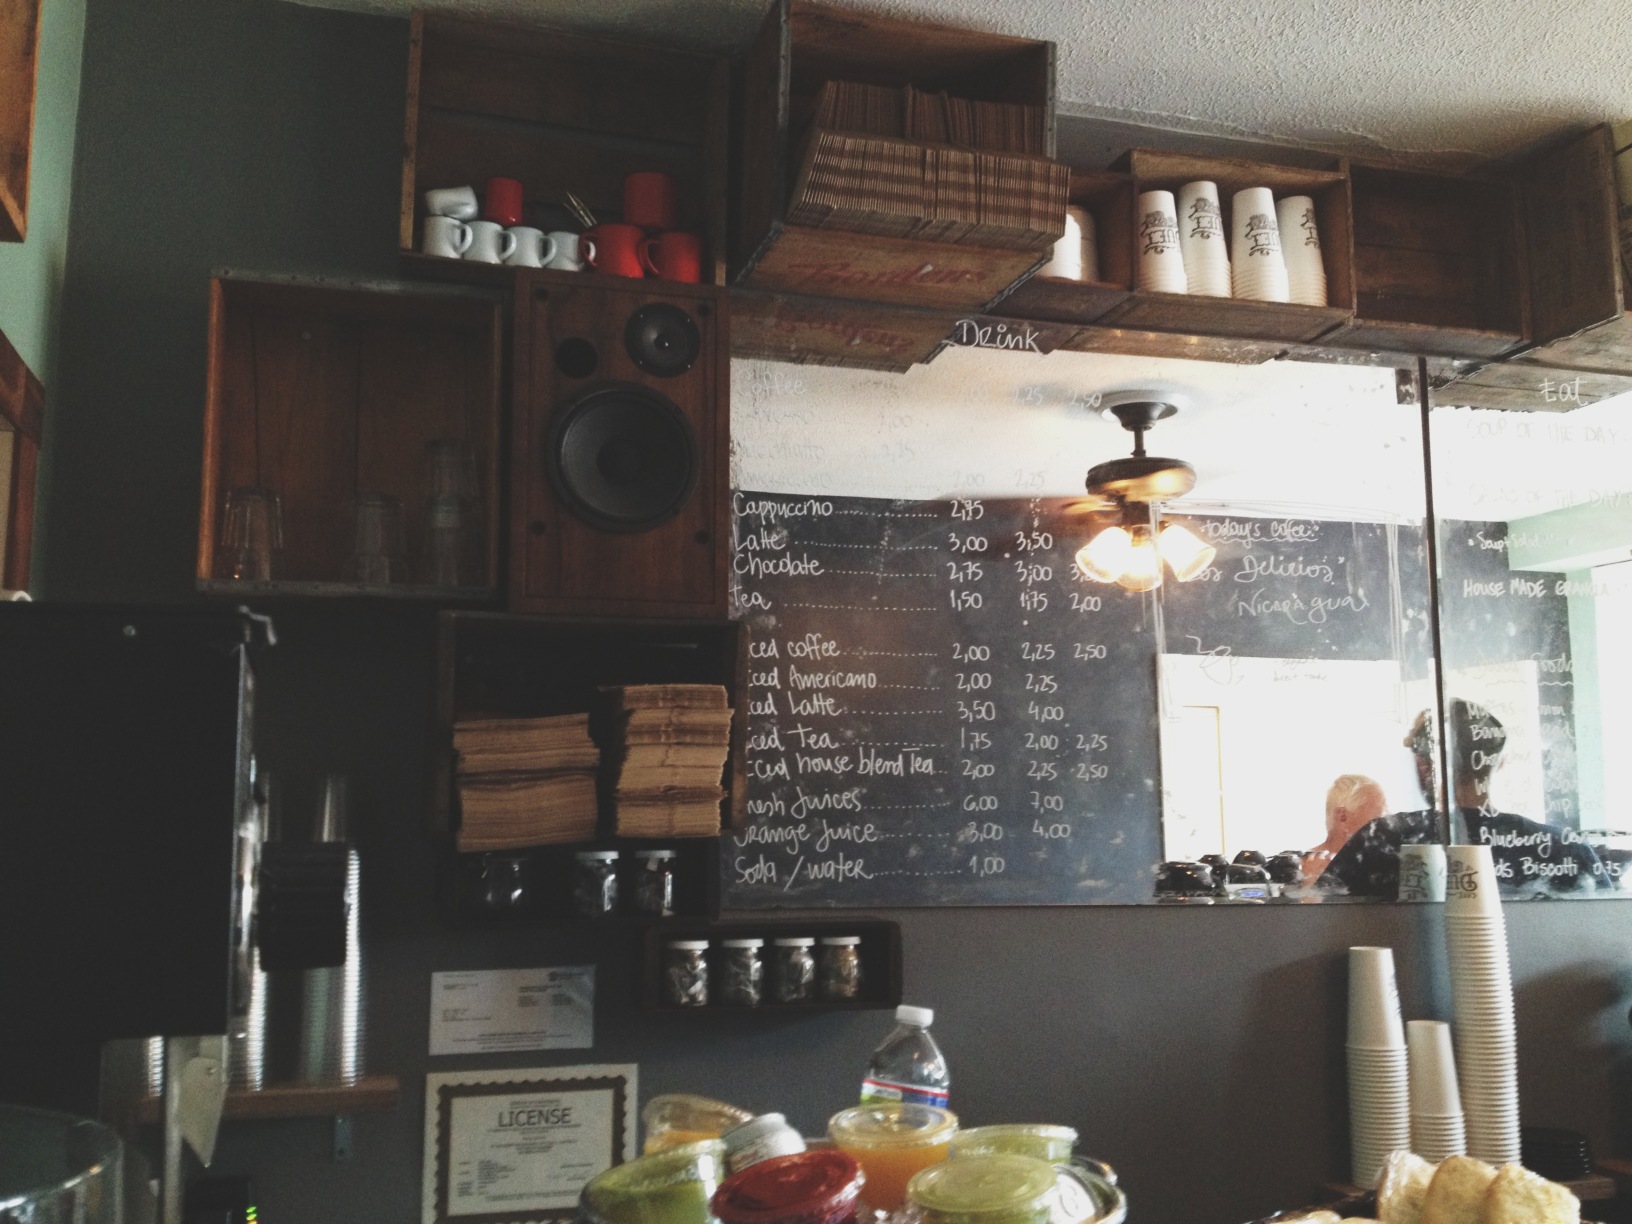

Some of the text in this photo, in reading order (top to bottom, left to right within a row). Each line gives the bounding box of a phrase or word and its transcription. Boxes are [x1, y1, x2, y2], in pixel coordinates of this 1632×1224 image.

[733, 492, 833, 525] Cappuccino
[732, 524, 1053, 553] Latte 3,00 3,50
[733, 552, 824, 579] Chocolate
[946, 562, 984, 582] 2,75
[1014, 561, 1053, 587] 3,00
[950, 589, 983, 612] 1,50
[1020, 590, 1048, 612] 1,75
[1069, 592, 1102, 613] 2,00
[1509, 578, 1547, 598] MADE
[749, 633, 1108, 663] ced coffee 2,00 2,25 2,50
[748, 664, 1058, 693] ced Americano 2,00 2,25
[748, 690, 1065, 723] ced Latte 3,50 4,00
[747, 726, 785, 751] ced
[960, 727, 992, 751] 1,75
[1024, 732, 1060, 751] 2,00
[1076, 733, 1108, 751] 2,25
[796, 752, 855, 774] house
[856, 746, 905, 777] blend
[902, 748, 934, 776] Tea
[961, 759, 995, 780] 2,00
[1026, 760, 1058, 781] 2,25
[1076, 763, 1109, 782] 2,50
[747, 792, 786, 817] resh
[963, 794, 999, 812] 6,00
[1030, 791, 1064, 814] 7,00
[966, 821, 1003, 843] 3,00
[1032, 819, 1072, 839] 4,00
[1480, 826, 1552, 858] Blueberry
[734, 854, 778, 884] Soda
[969, 855, 1006, 878] 1,00
[1519, 856, 1579, 877] Biscotti
[498, 1106, 574, 1128] LICENSE
